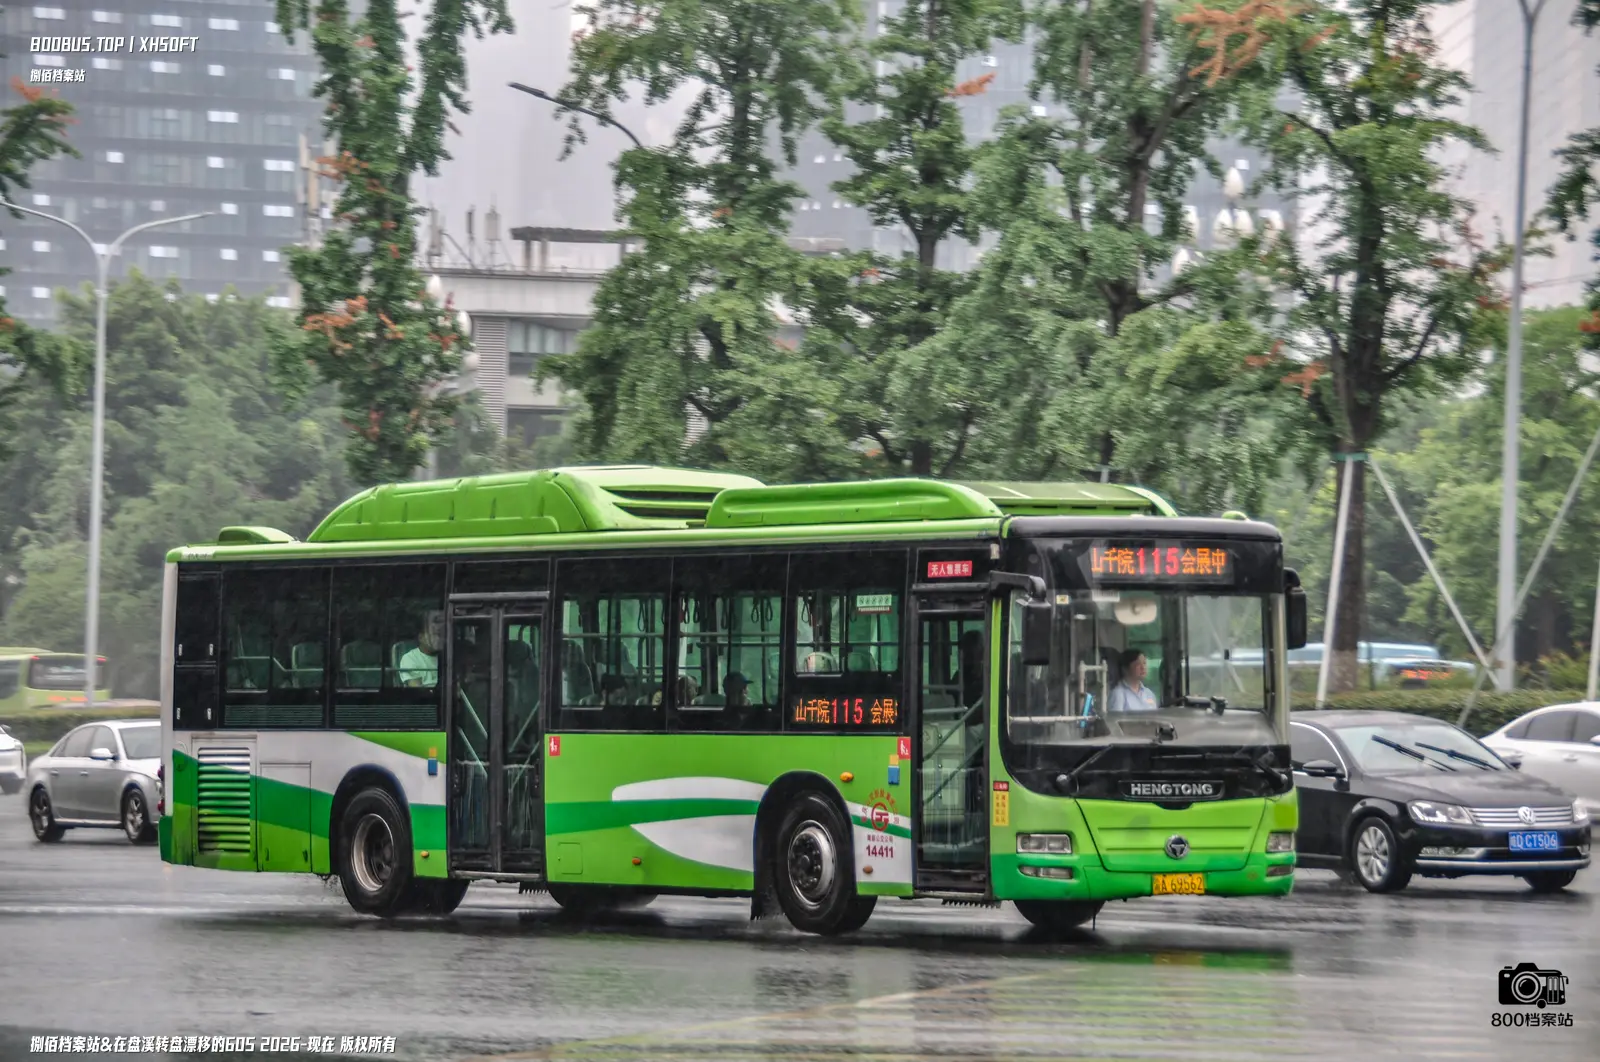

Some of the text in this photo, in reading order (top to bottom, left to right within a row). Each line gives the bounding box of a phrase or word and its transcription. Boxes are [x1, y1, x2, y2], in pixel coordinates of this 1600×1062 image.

[1136, 548, 1180, 575] 115
[1180, 548, 1227, 575] 会展中
[795, 699, 899, 724] 山千院 115 会展
[1130, 783, 1213, 796] HENGTONG
[866, 844, 894, 858] 14411
